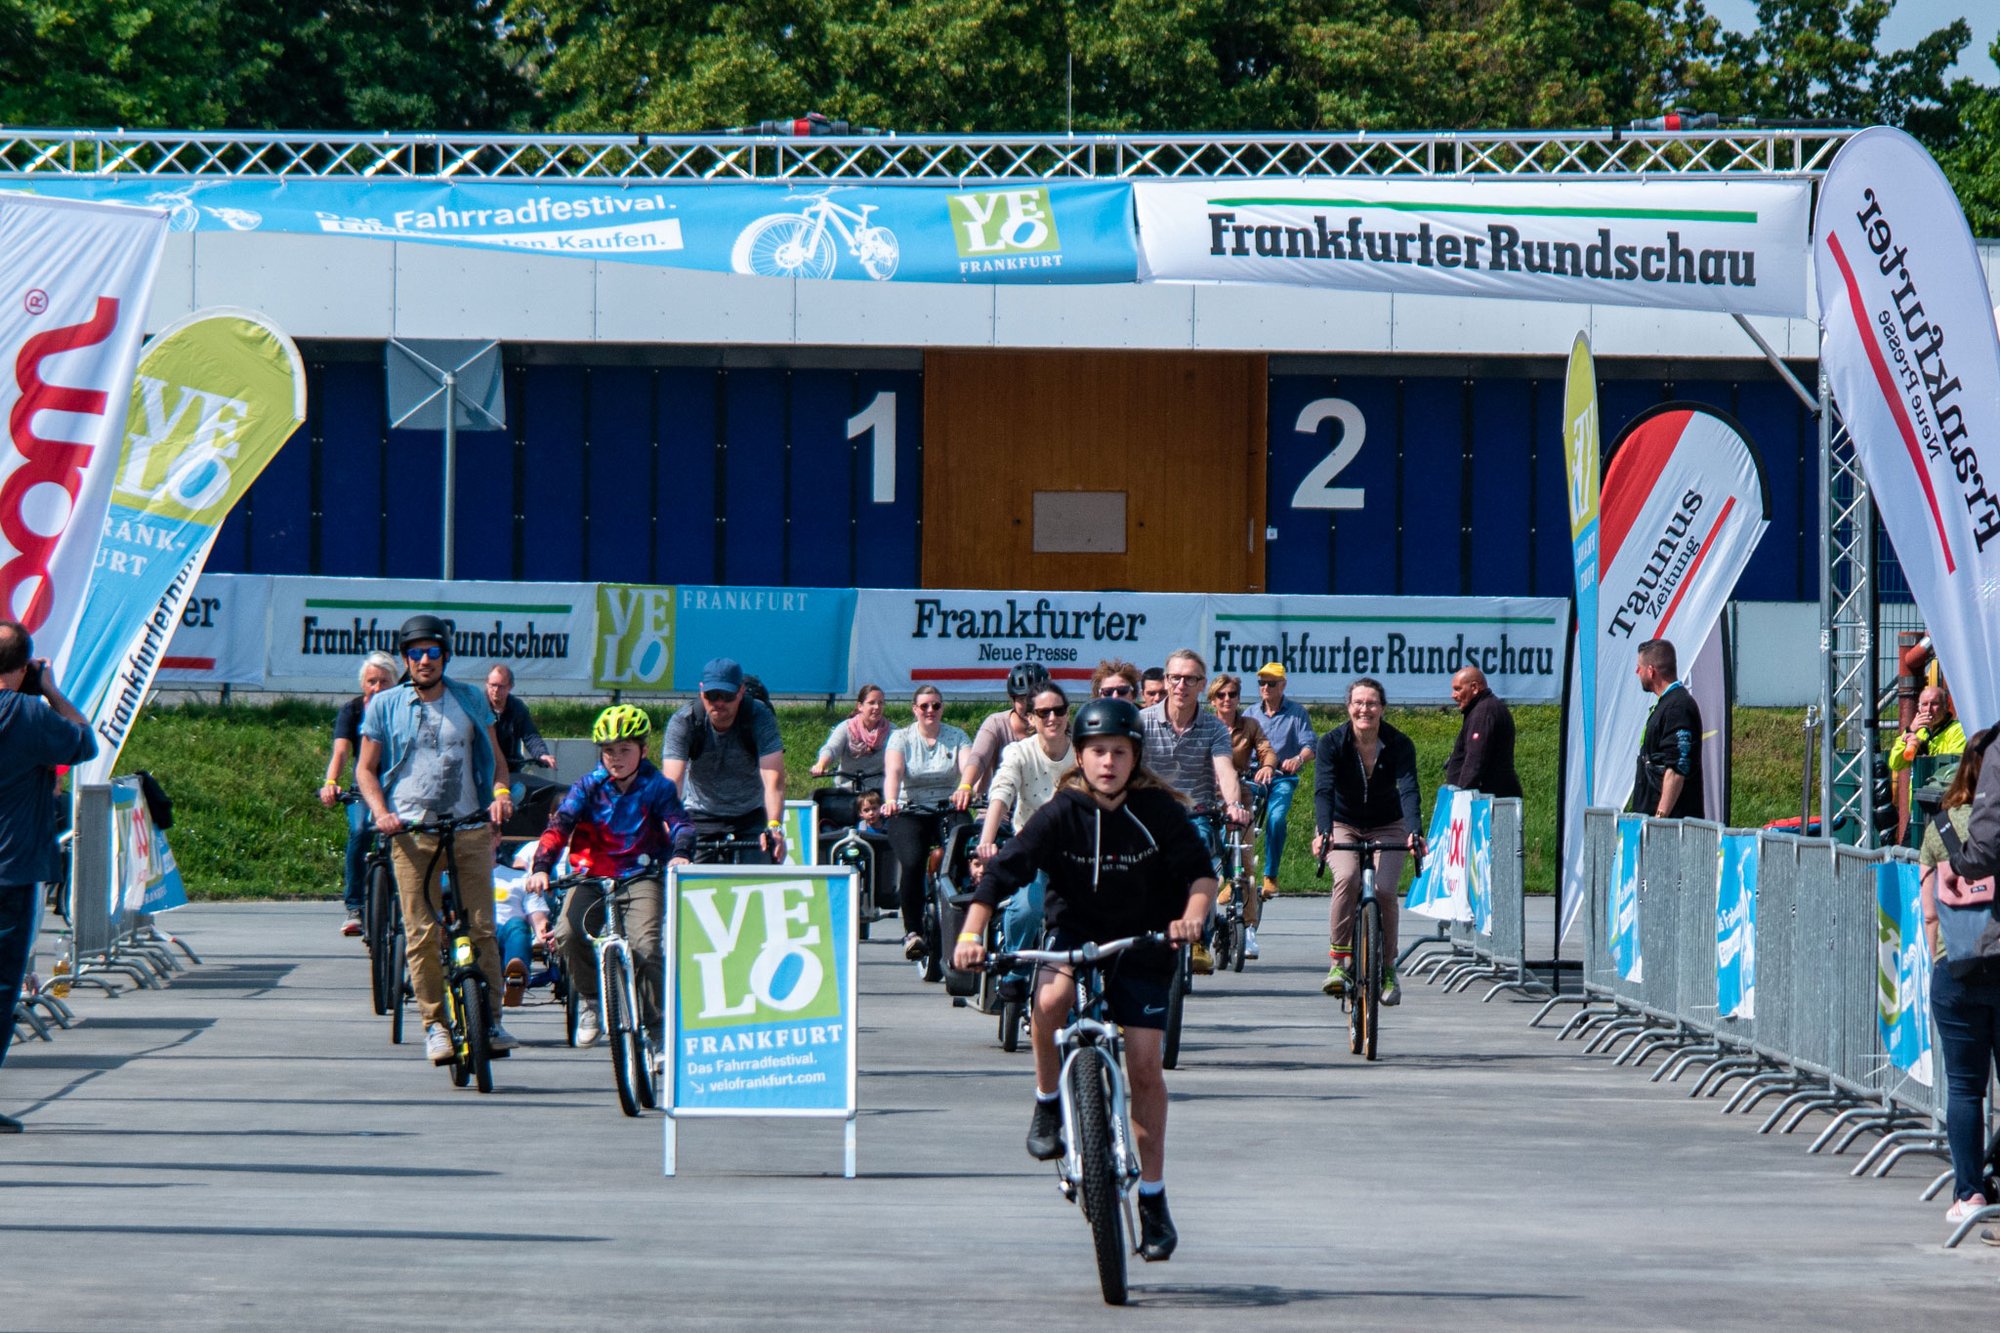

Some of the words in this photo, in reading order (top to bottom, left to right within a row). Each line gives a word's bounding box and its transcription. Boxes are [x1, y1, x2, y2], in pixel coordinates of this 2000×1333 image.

[395, 194, 677, 230] Fahrradfestival.
[557, 232, 667, 249] Kaufen.
[1207, 212, 1486, 270] Frankfurter
[1487, 223, 1757, 287] Rundschau
[960, 255, 1062, 273] FRANKFURT
[847, 391, 896, 502] 1
[1291, 398, 1367, 508] 2
[1608, 488, 1703, 639] Taunus
[1646, 535, 1701, 620] Zeitung
[683, 591, 808, 611] FRANKFURT
[912, 598, 1147, 641] Frankfurter
[978, 643, 1023, 661] Neue
[1025, 643, 1077, 662] Presse
[1214, 630, 1384, 674] Frankfurter
[1386, 632, 1554, 676] Rundschau
[99, 597, 174, 749] Frankfurter
[684, 1024, 843, 1056] FRANKFURT
[688, 1061, 713, 1075] Das
[716, 1052, 818, 1072] Fahrradfestival.
[710, 1072, 826, 1091] velofrankfurt.com
